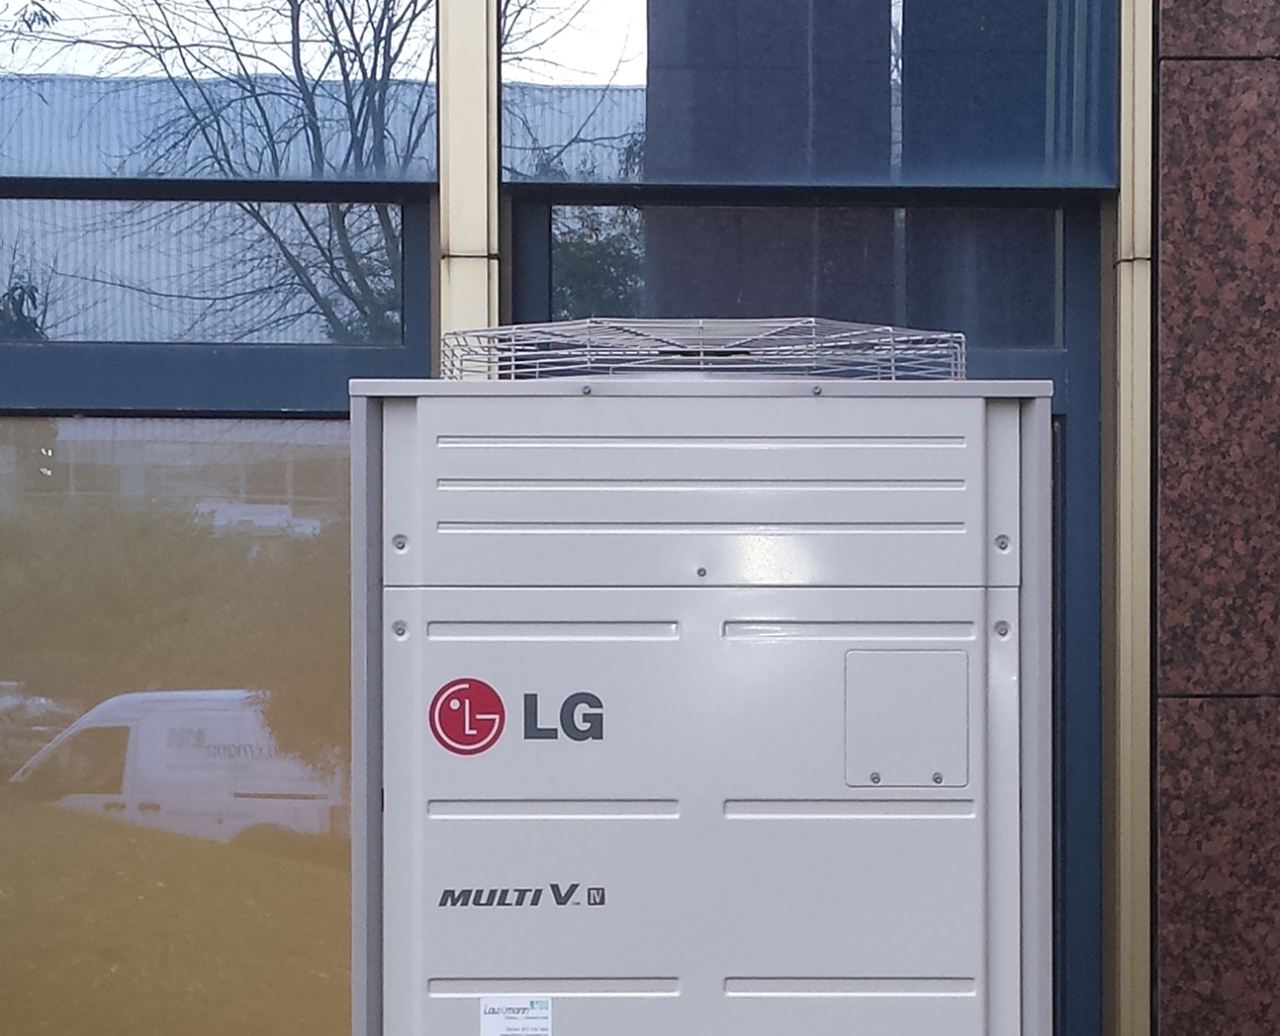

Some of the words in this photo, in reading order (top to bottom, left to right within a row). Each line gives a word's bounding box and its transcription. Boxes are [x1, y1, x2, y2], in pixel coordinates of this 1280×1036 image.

[523, 691, 604, 741] LG
[438, 888, 543, 906] MULTI
[587, 888, 605, 906] IV
